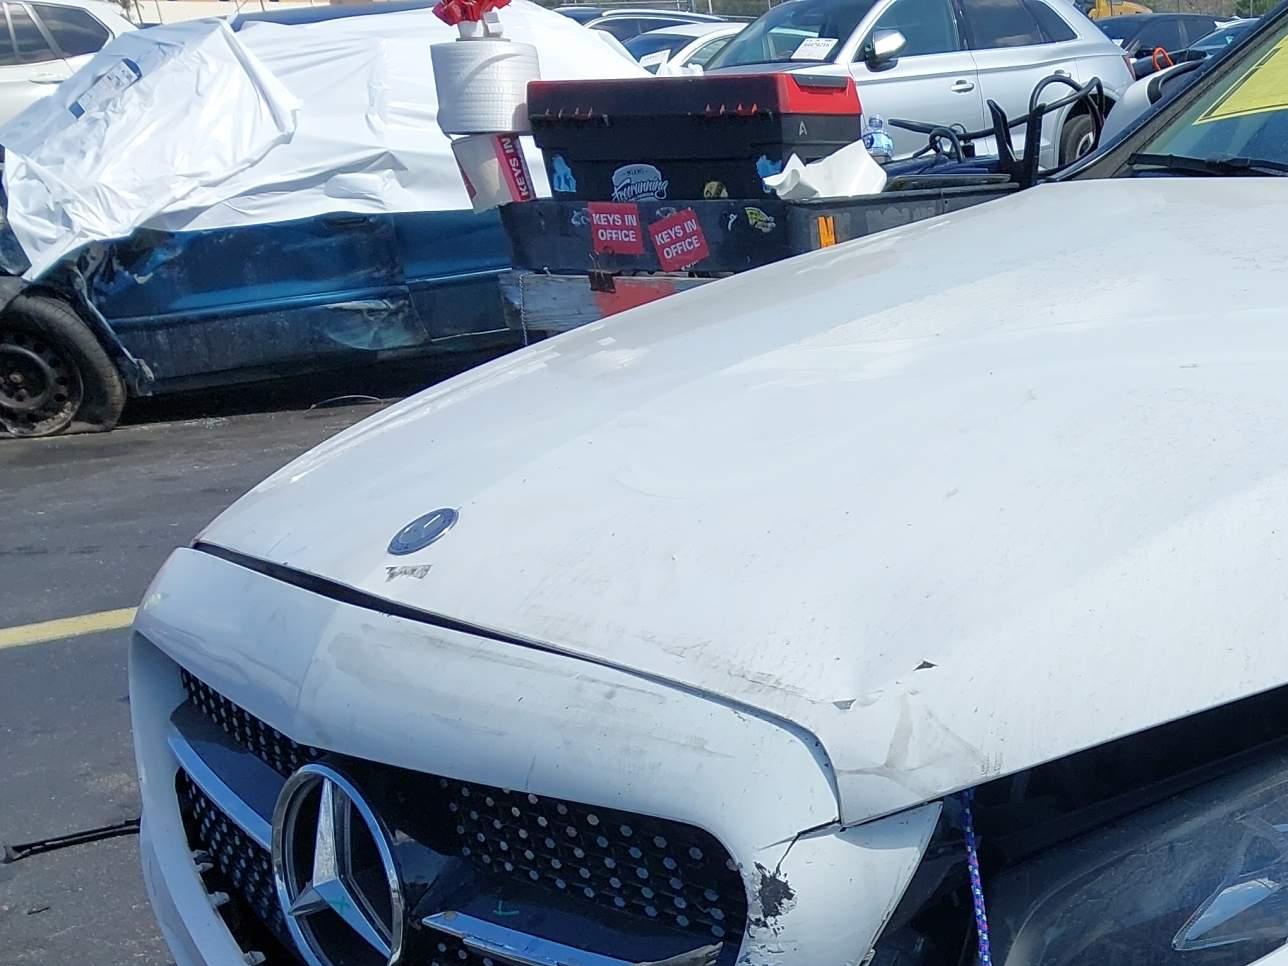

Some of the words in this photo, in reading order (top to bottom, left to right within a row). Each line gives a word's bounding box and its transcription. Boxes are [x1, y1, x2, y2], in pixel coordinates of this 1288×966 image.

[501, 137, 514, 154] IN
[509, 157, 529, 197] KEYS
[592, 213, 622, 226] KEYS
[624, 214, 637, 226] IN
[598, 229, 637, 242] OFFICE
[654, 225, 683, 246] KEYS
[684, 219, 697, 232] IN
[663, 235, 701, 260] OFFICE
